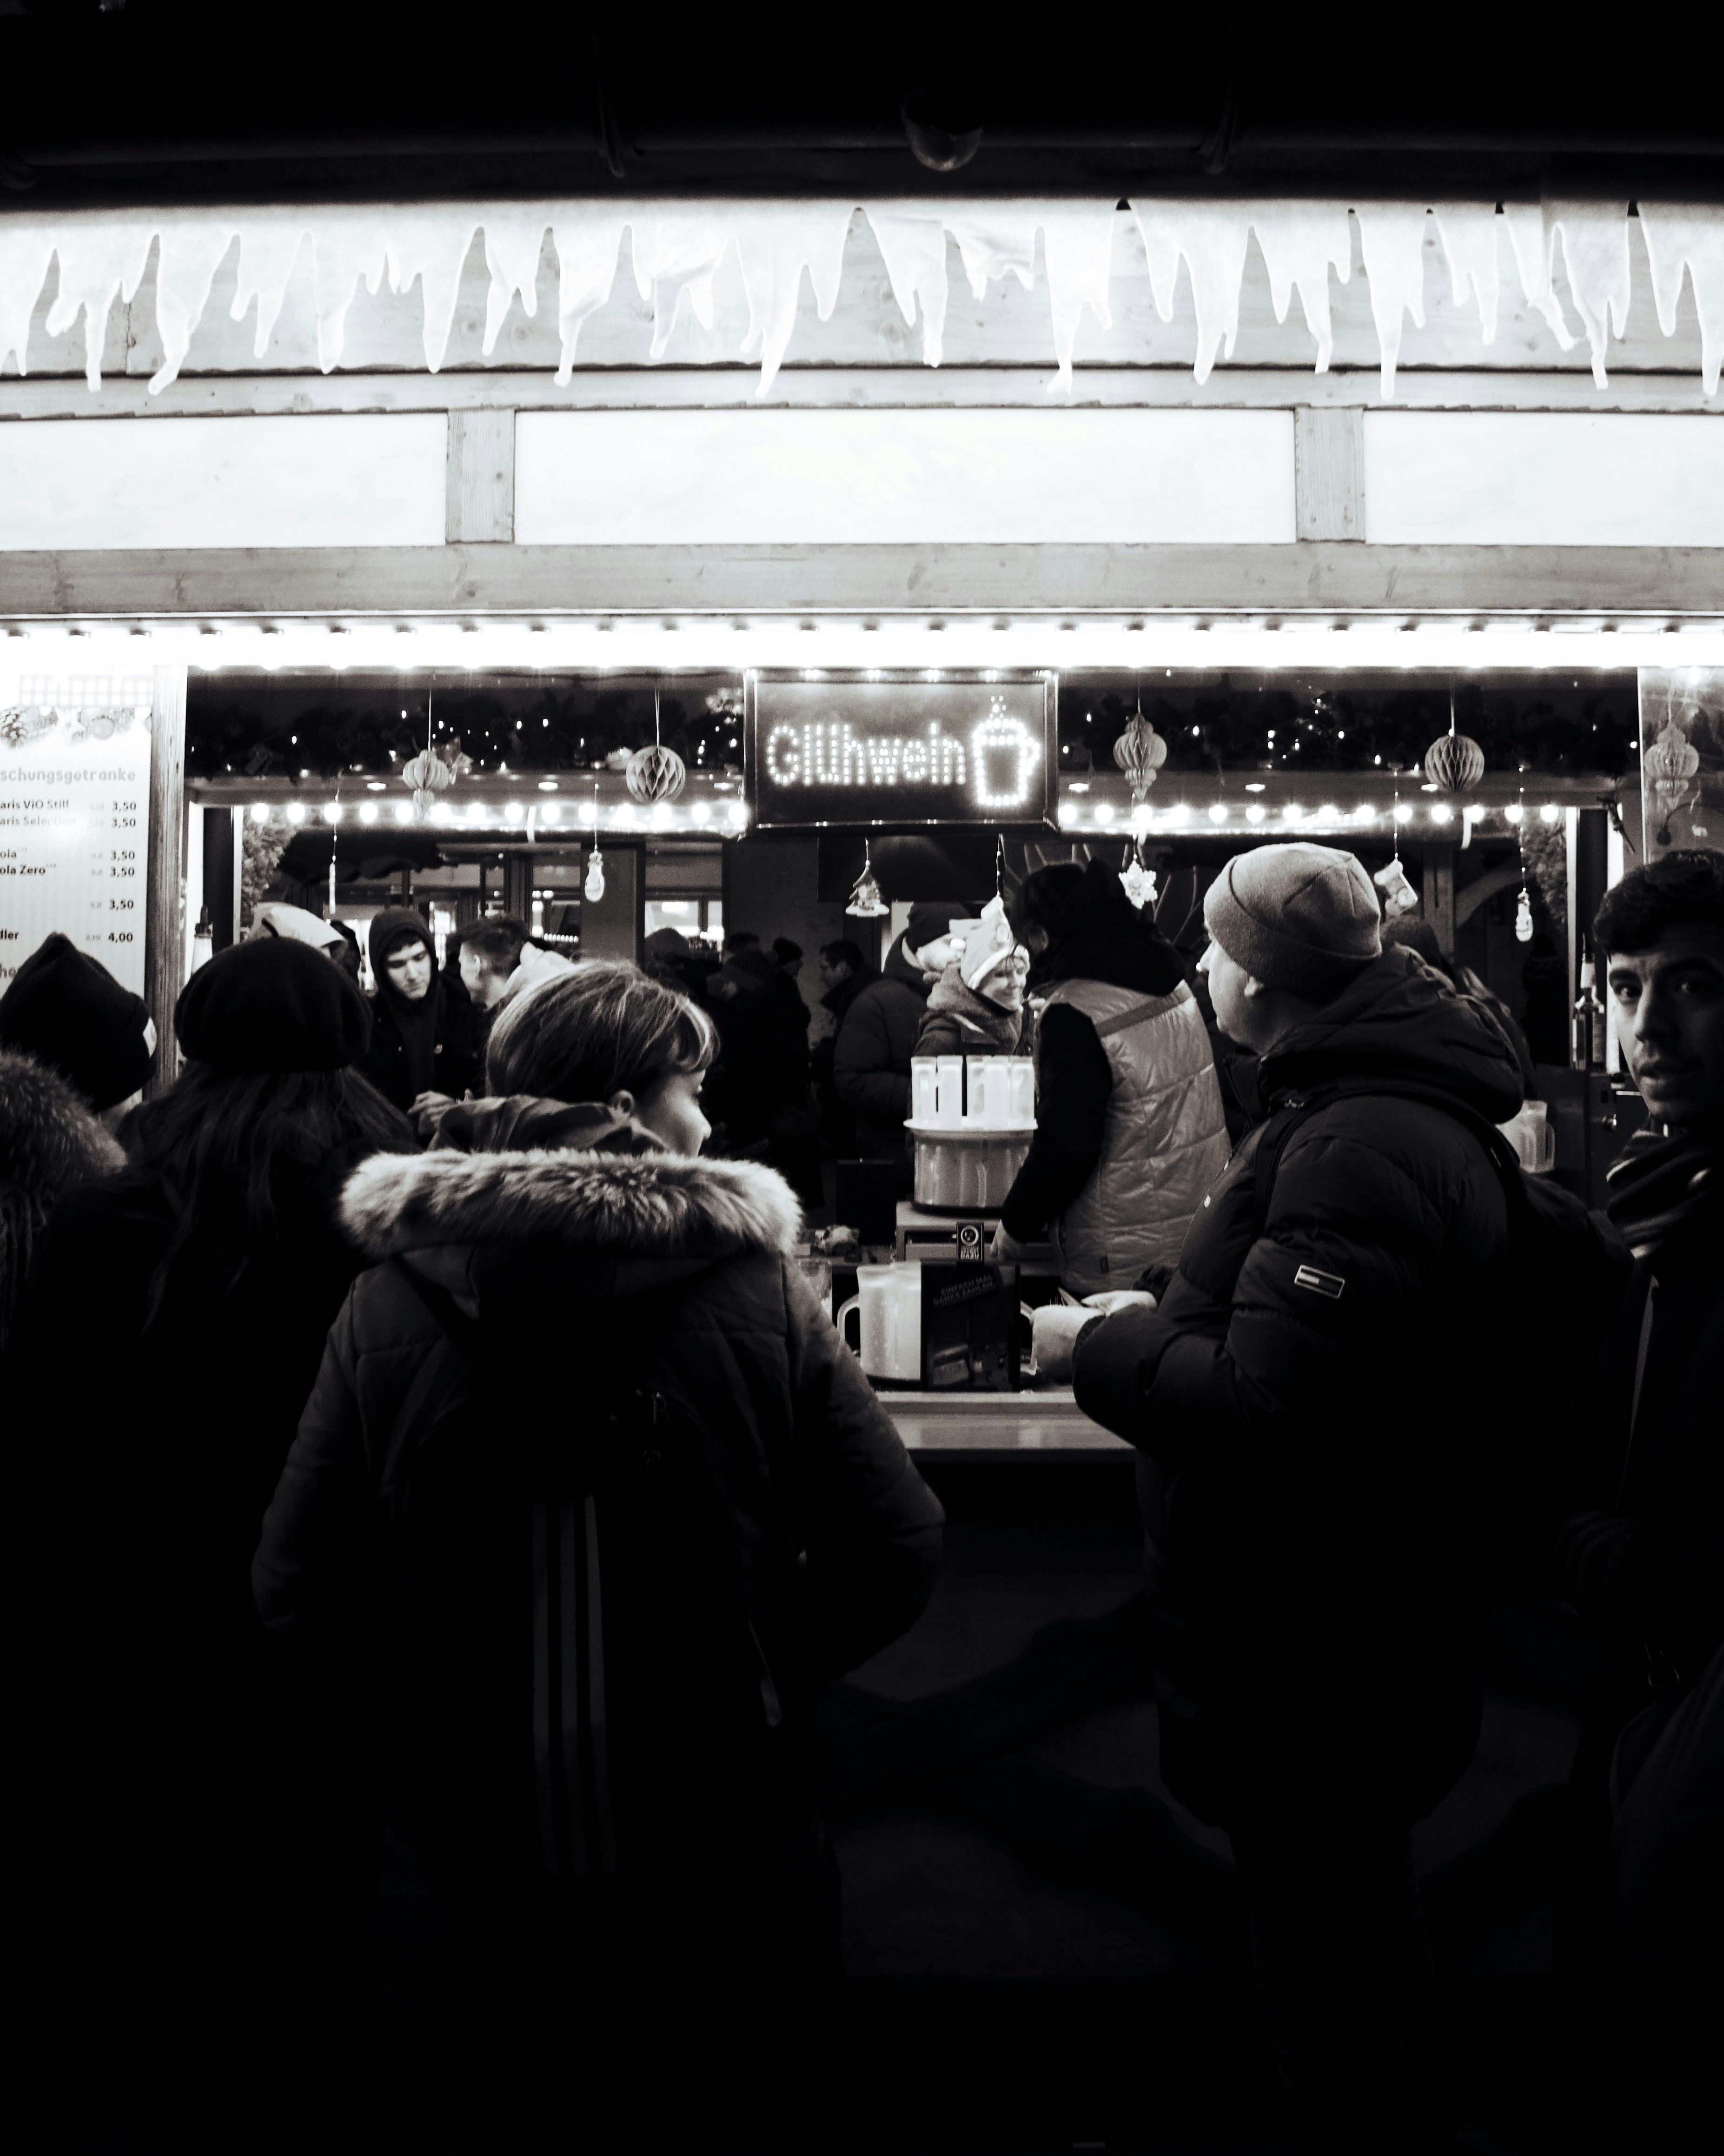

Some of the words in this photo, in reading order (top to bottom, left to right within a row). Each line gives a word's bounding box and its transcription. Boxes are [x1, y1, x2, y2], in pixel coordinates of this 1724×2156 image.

[112, 800, 137, 812] 3,50
[111, 817, 136, 829] 3,50
[111, 850, 135, 861] 3,50
[20, 865, 46, 875] Zero
[110, 866, 135, 878] 3,50
[109, 898, 134, 911] 3,50
[108, 932, 133, 944] 4,00
